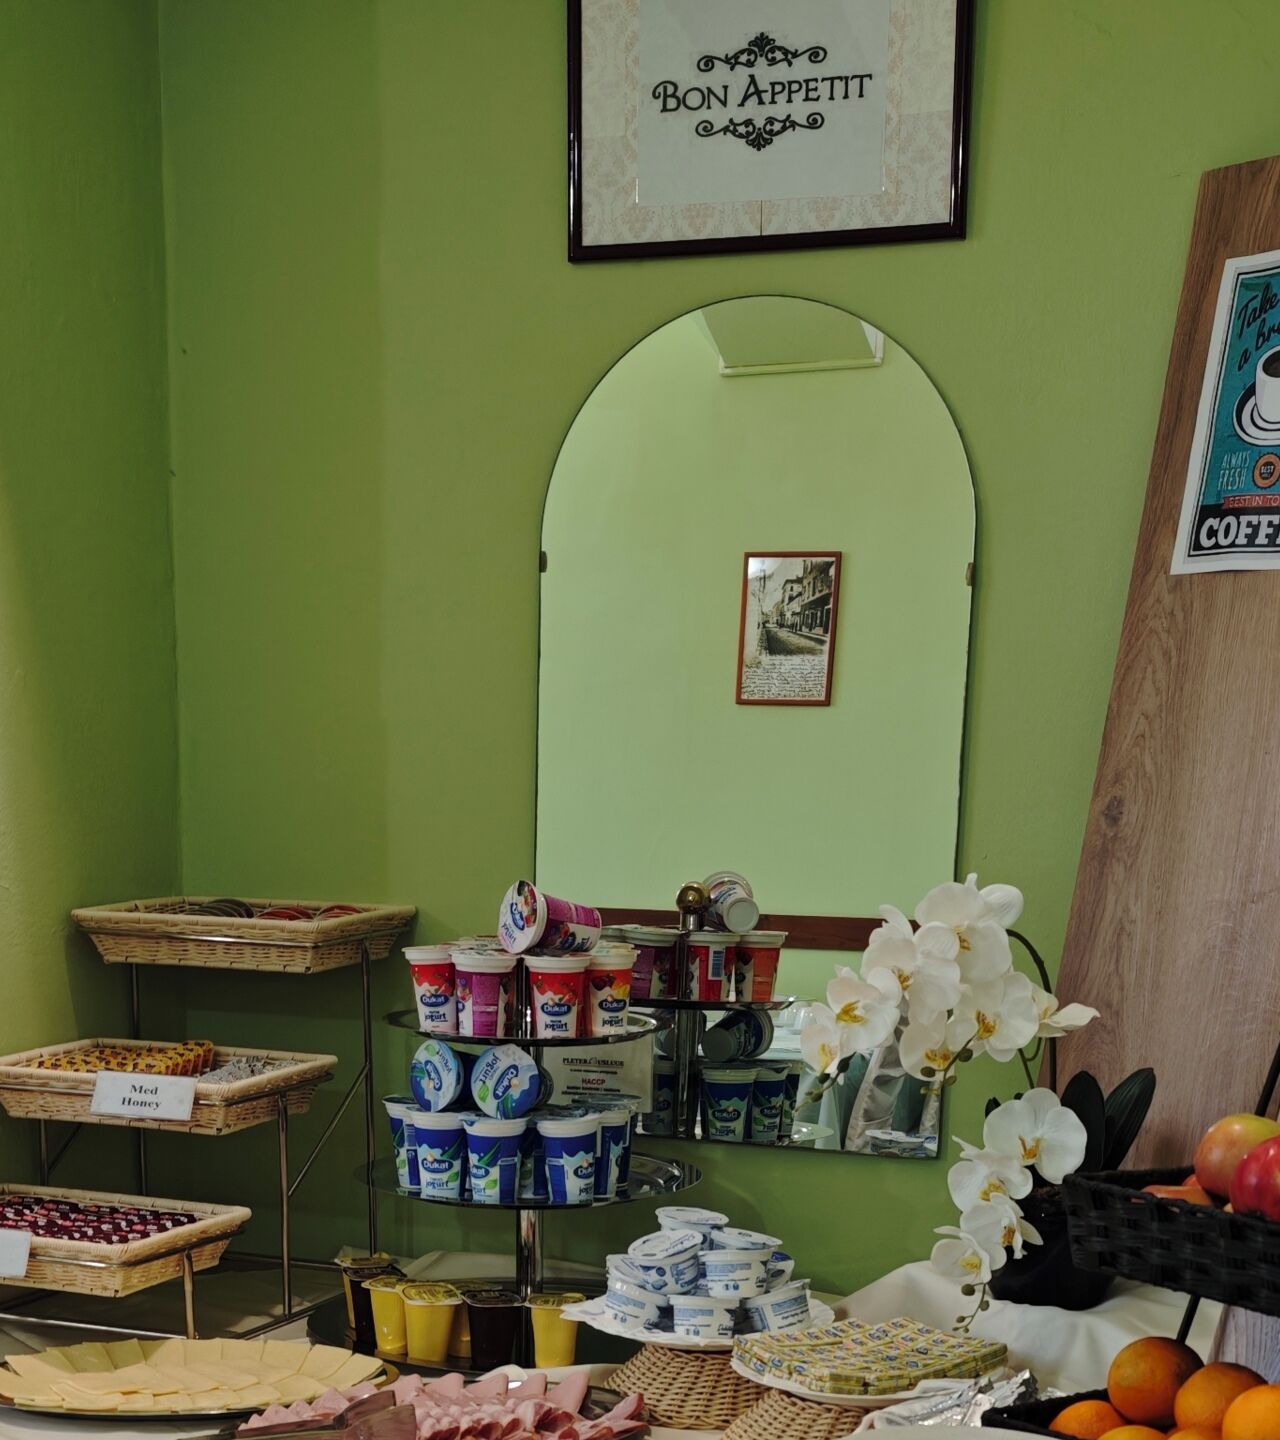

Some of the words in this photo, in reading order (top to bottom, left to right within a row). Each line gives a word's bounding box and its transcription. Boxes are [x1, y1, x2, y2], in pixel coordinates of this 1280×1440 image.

[652, 80, 729, 113] BON
[737, 74, 873, 107] APPETIT
[1238, 282, 1280, 339] Take
[1238, 348, 1252, 372] a
[1222, 451, 1251, 469] ALWAYS
[1217, 468, 1248, 490] FRESH
[1229, 495, 1249, 508] BEST
[1251, 494, 1263, 506] IN
[422, 995, 445, 1003] Dukat
[603, 1000, 625, 1008] Dukat
[544, 1005, 568, 1013] Dukat
[425, 1012, 446, 1022] jogurt
[602, 1017, 624, 1027] jogurt
[544, 1022, 568, 1032] jogurt
[480, 1052, 502, 1084] jogurt
[496, 1068, 517, 1097] Dukat
[131, 1084, 159, 1096] Med
[121, 1096, 162, 1111] Honey
[423, 1161, 449, 1169] Dukat
[425, 1180, 449, 1190] jogurt
